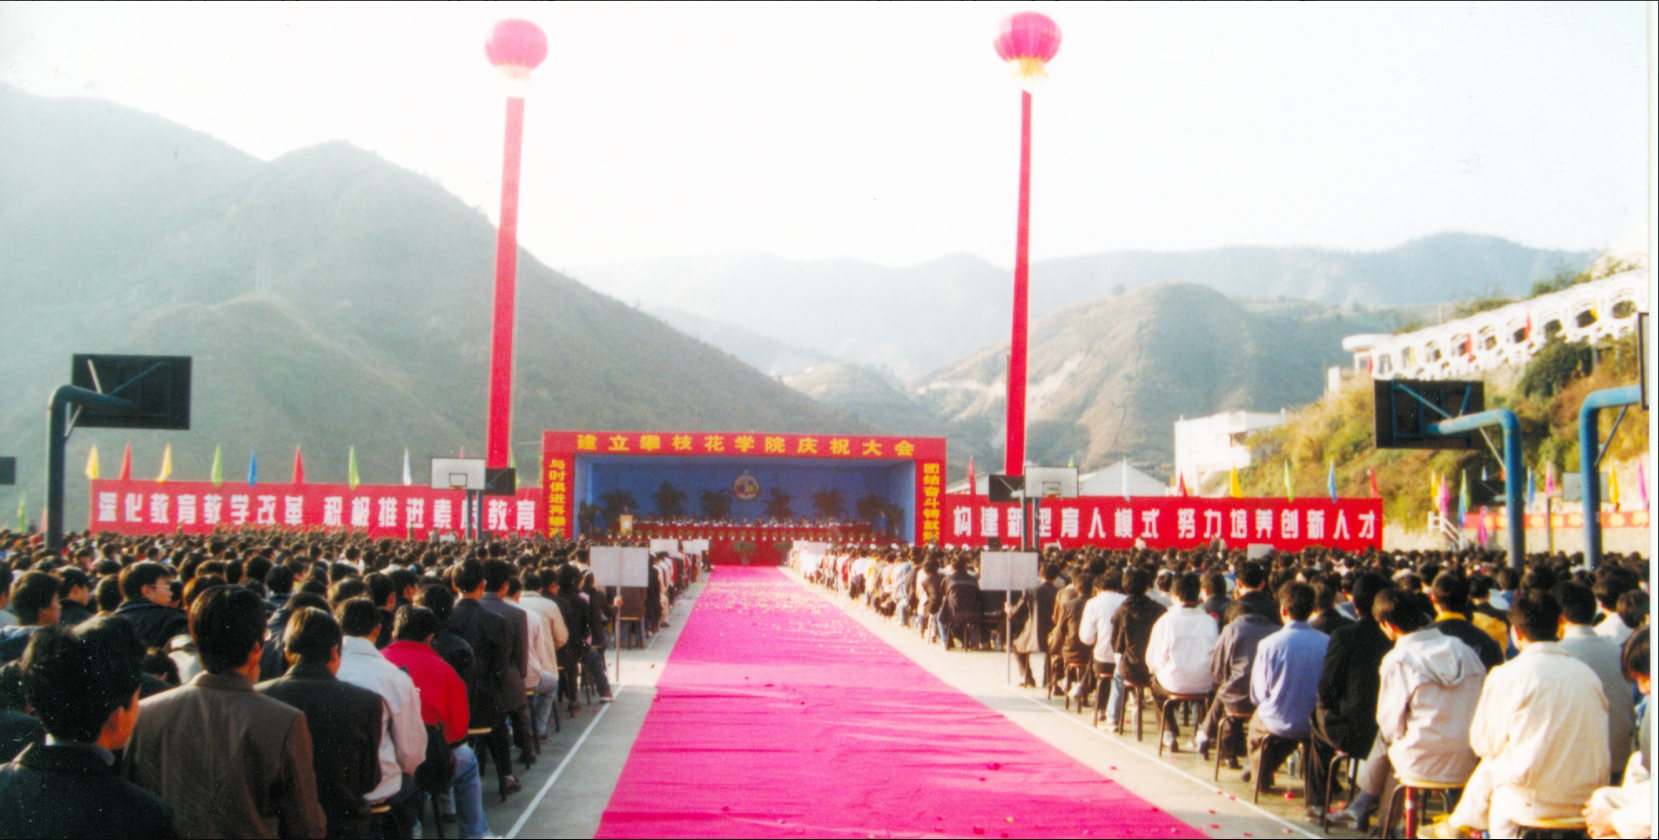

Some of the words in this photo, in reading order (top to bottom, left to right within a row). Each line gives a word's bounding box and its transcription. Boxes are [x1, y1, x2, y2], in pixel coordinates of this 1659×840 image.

[577, 434, 914, 456] 建立攀枝花学院庆祝大会
[98, 491, 304, 526] 深化教育教学改革
[323, 496, 536, 531] 积极推进素质教育
[922, 463, 940, 547] 团结奋斗铸就辉
[953, 505, 1160, 539] 构建新型育人模式
[1177, 507, 1376, 540] 努力培养创新人才
